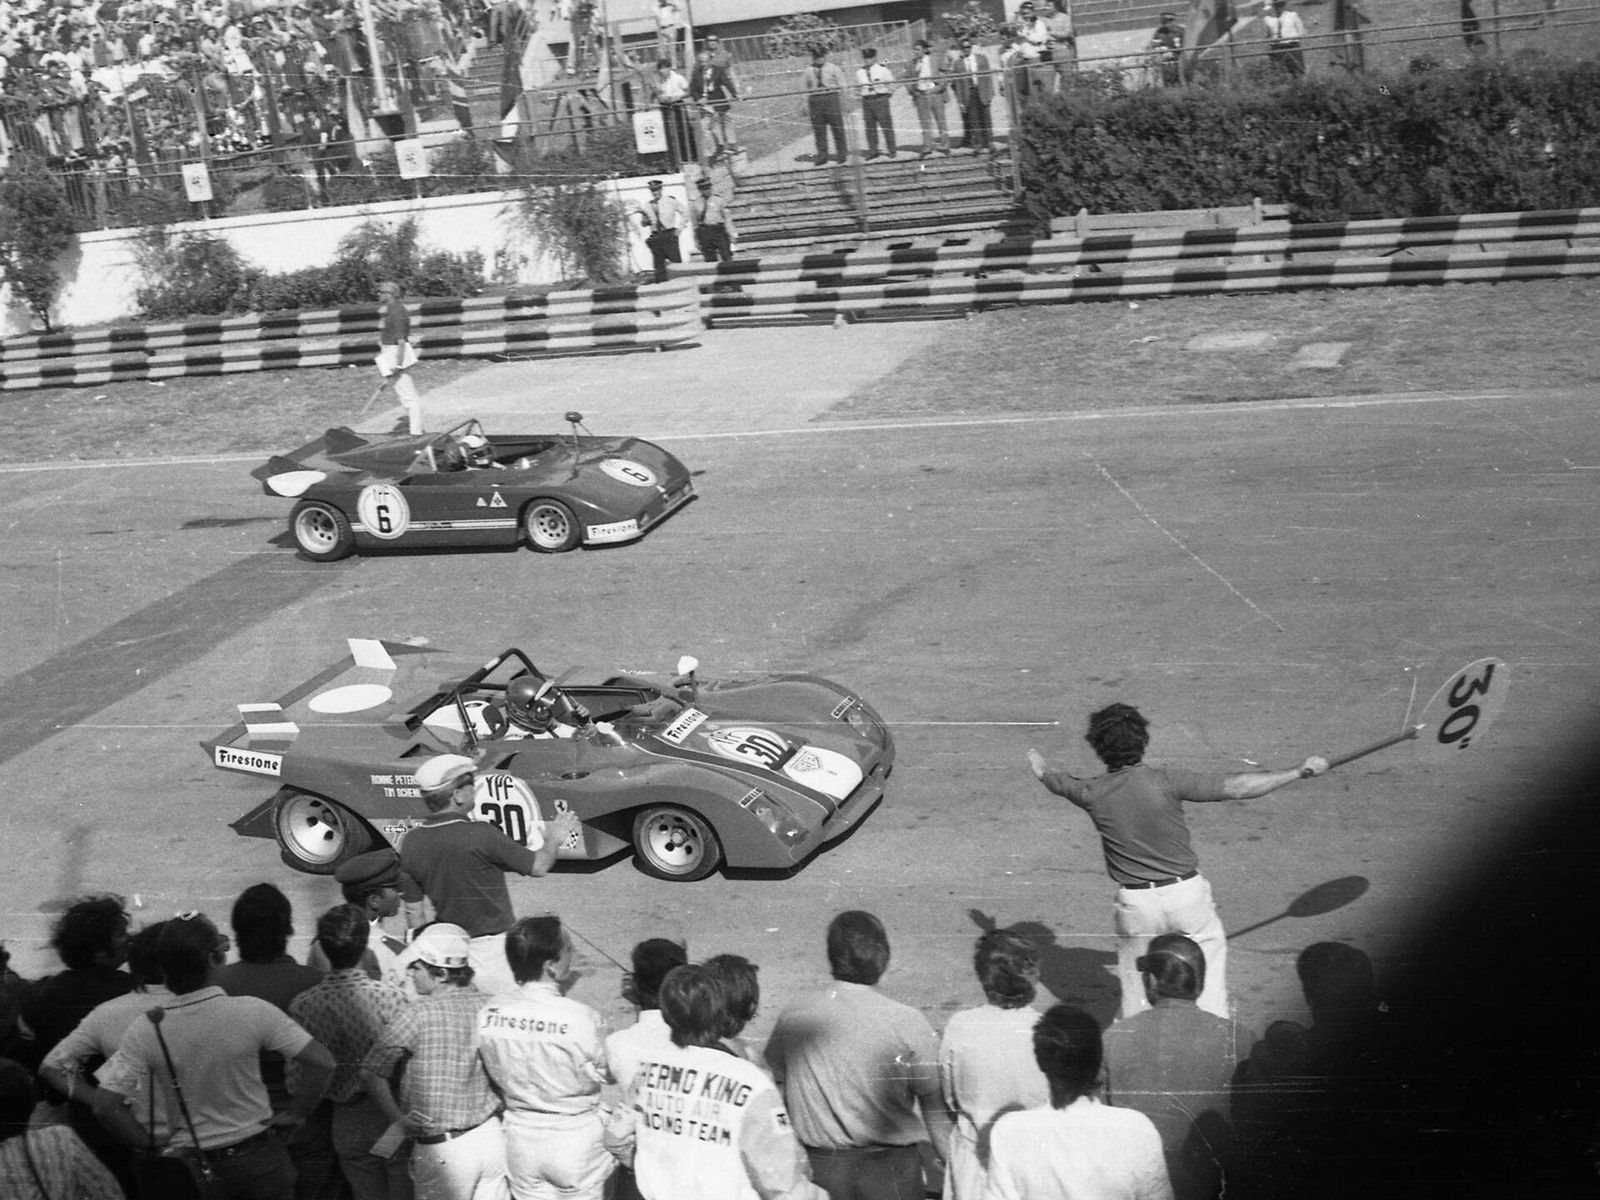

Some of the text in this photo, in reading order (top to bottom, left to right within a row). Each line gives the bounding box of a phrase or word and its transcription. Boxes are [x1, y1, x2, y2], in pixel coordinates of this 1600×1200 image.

[622, 467, 649, 482] 6
[376, 505, 393, 533] 6
[667, 710, 703, 740] Firestone
[218, 749, 279, 771] Firestone
[736, 735, 785, 768] 30
[486, 774, 514, 801] YPF
[481, 803, 527, 847] 30
[481, 1007, 568, 1035] Firestone
[701, 1072, 752, 1107] KING
[689, 1120, 731, 1146] TEAM
